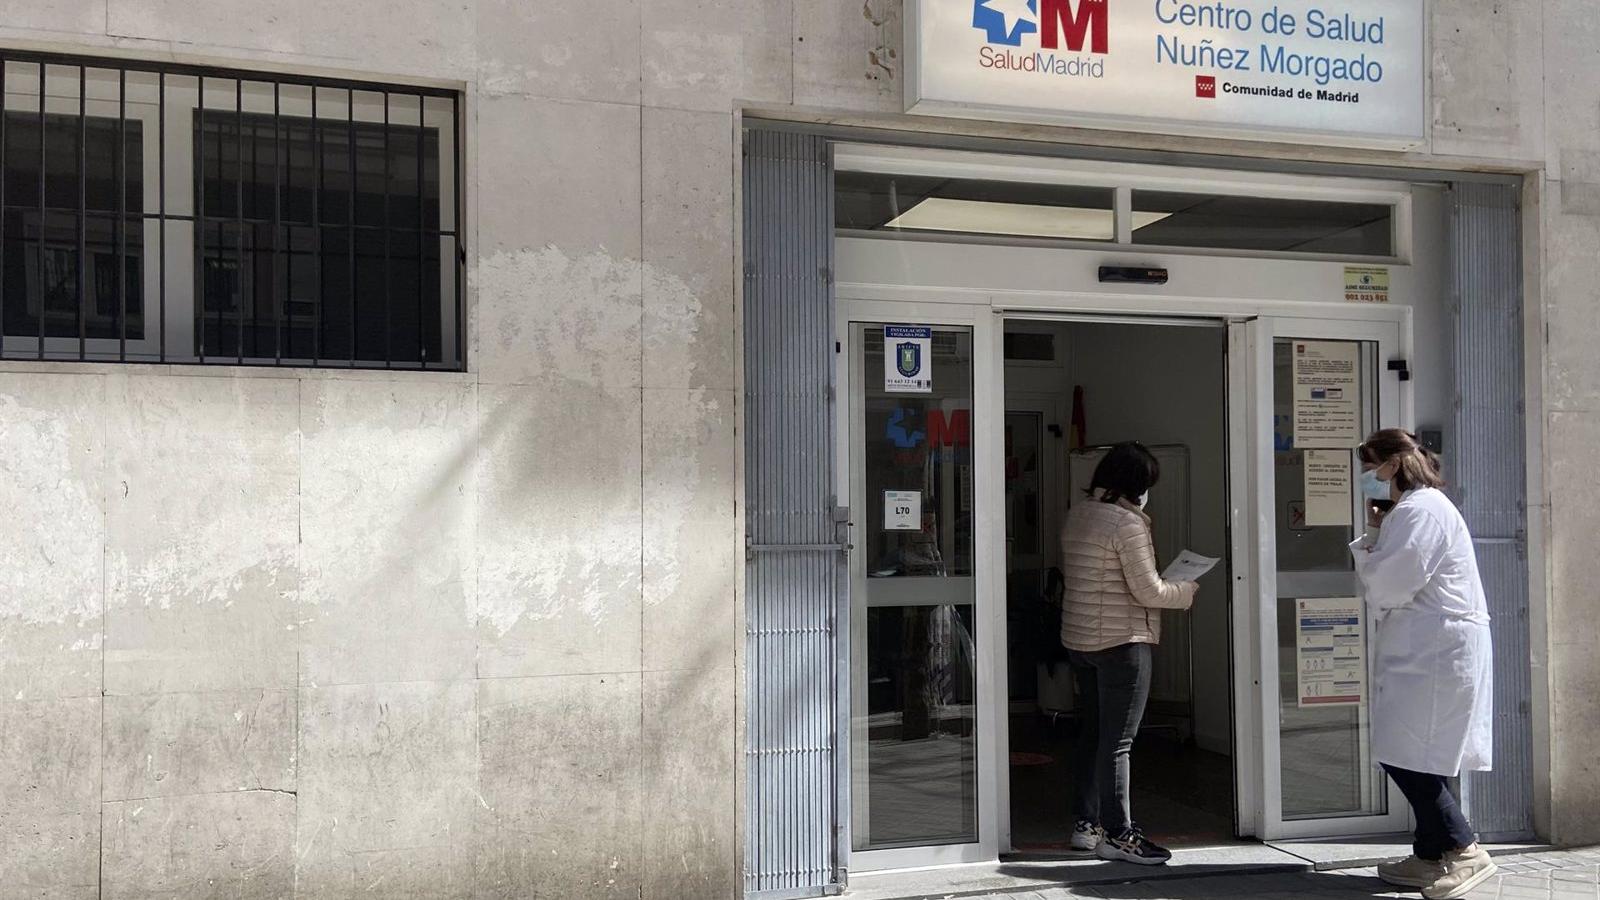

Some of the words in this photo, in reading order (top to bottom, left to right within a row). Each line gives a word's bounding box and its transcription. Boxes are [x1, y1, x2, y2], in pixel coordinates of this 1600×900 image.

[1155, 0, 1252, 32] Centro
[1261, 6, 1296, 36] de
[1306, 9, 1384, 44] Salud
[979, 46, 1104, 78] SaludMadrid
[1156, 34, 1250, 71] Nuñez
[1260, 44, 1383, 86] Morgado
[1222, 82, 1293, 99] Comunidad
[1298, 88, 1313, 100] de
[1316, 89, 1359, 103] Madrid
[895, 507, 910, 515] L70
